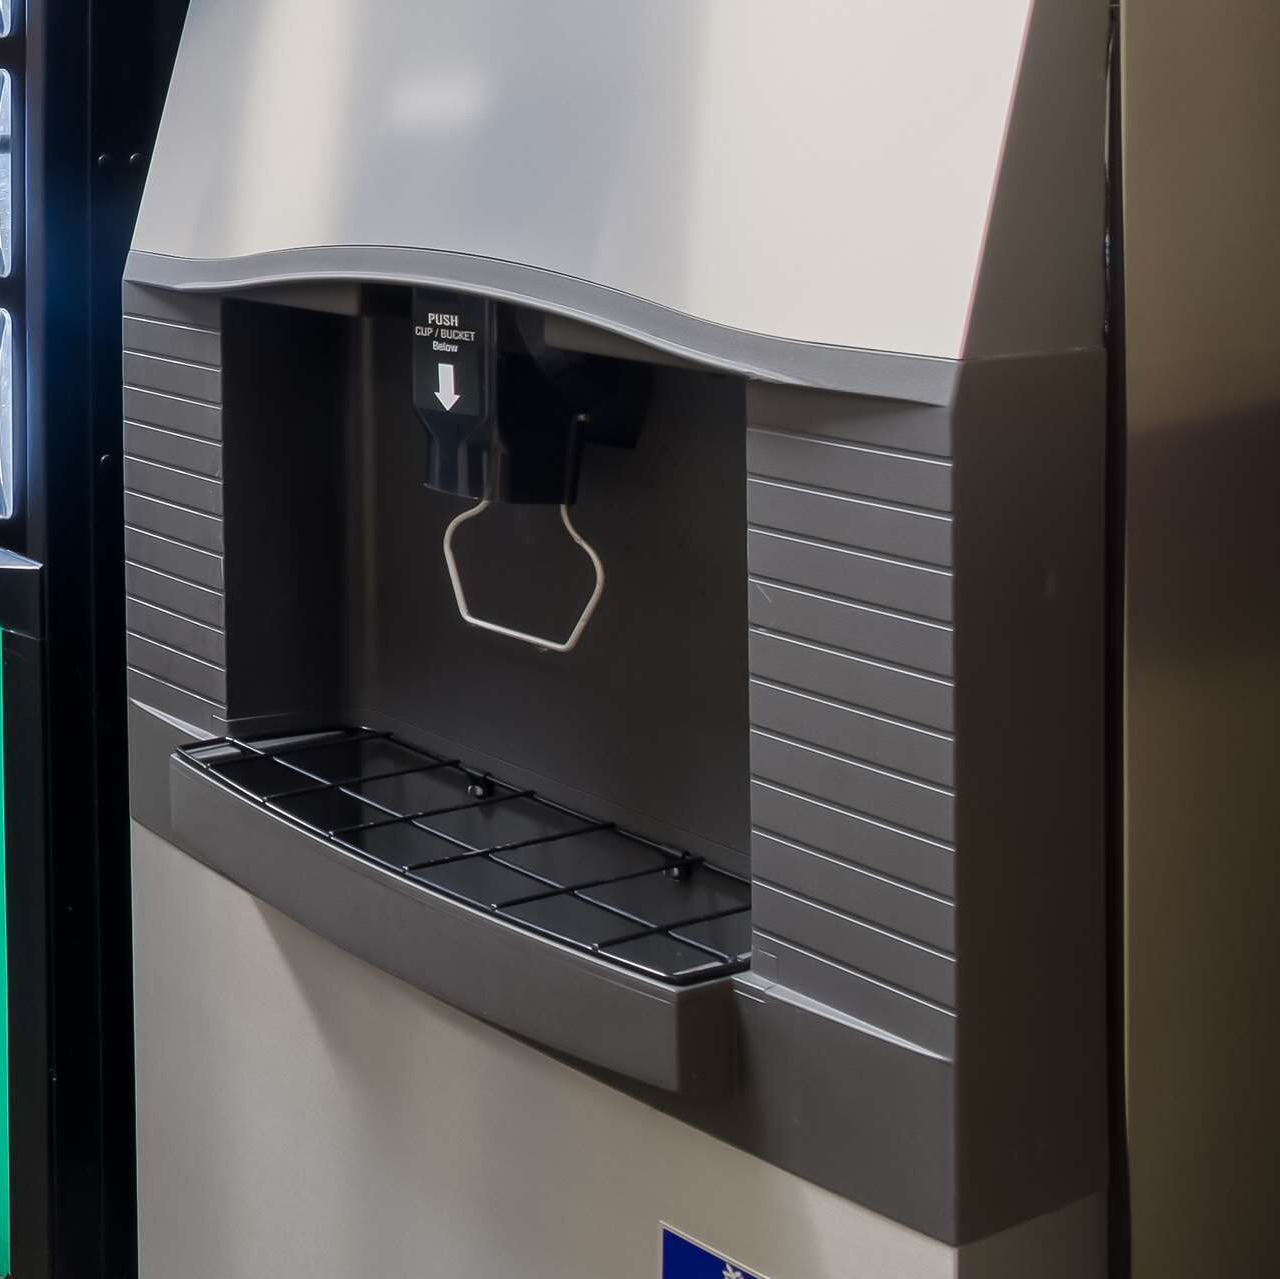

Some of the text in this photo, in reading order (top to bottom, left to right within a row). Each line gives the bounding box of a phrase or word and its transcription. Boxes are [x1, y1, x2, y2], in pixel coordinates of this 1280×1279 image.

[428, 313, 458, 327] PUSH
[415, 326, 433, 337] CUP
[440, 329, 475, 341] BUCKET
[432, 340, 458, 353] Below
